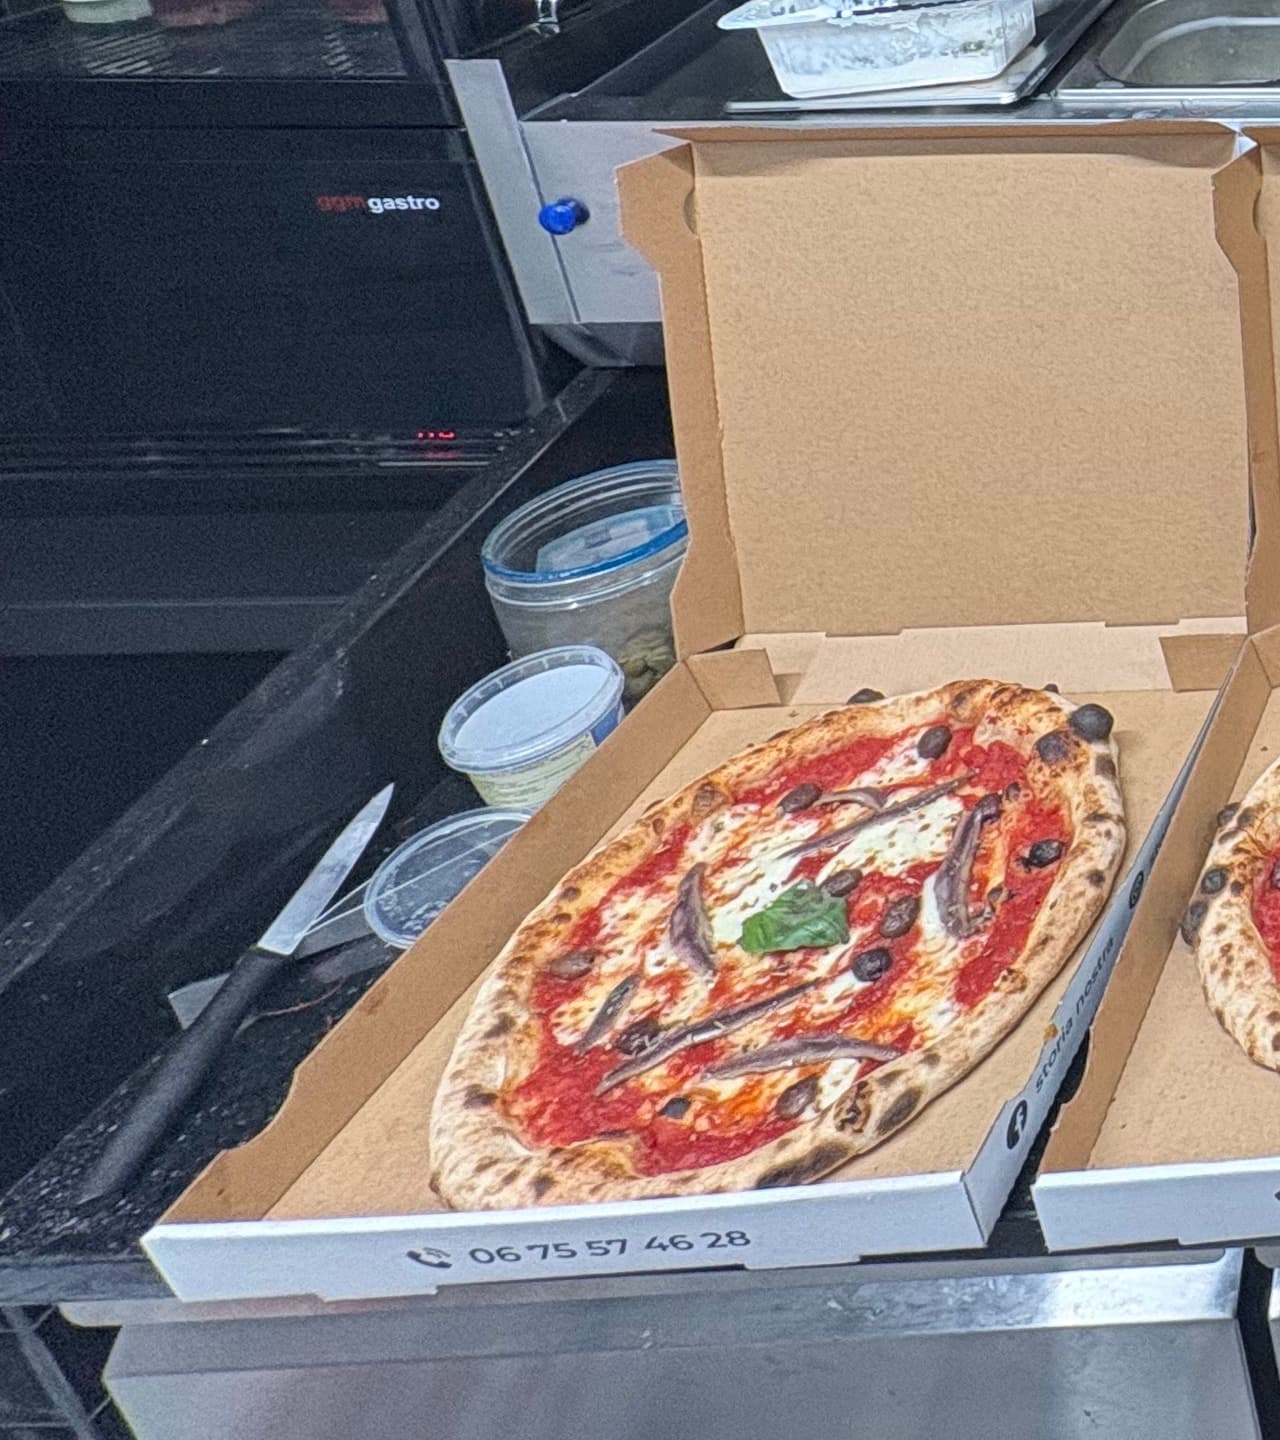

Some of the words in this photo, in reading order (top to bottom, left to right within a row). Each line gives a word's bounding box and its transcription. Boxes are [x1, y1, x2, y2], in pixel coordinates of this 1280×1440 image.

[1035, 1017, 1073, 1094] storia
[1075, 936, 1115, 1015] nostra
[468, 1246, 522, 1265] 06
[525, 1243, 578, 1260] 75
[586, 1238, 629, 1257] 57
[644, 1234, 695, 1251] 46
[700, 1230, 751, 1249] 28
